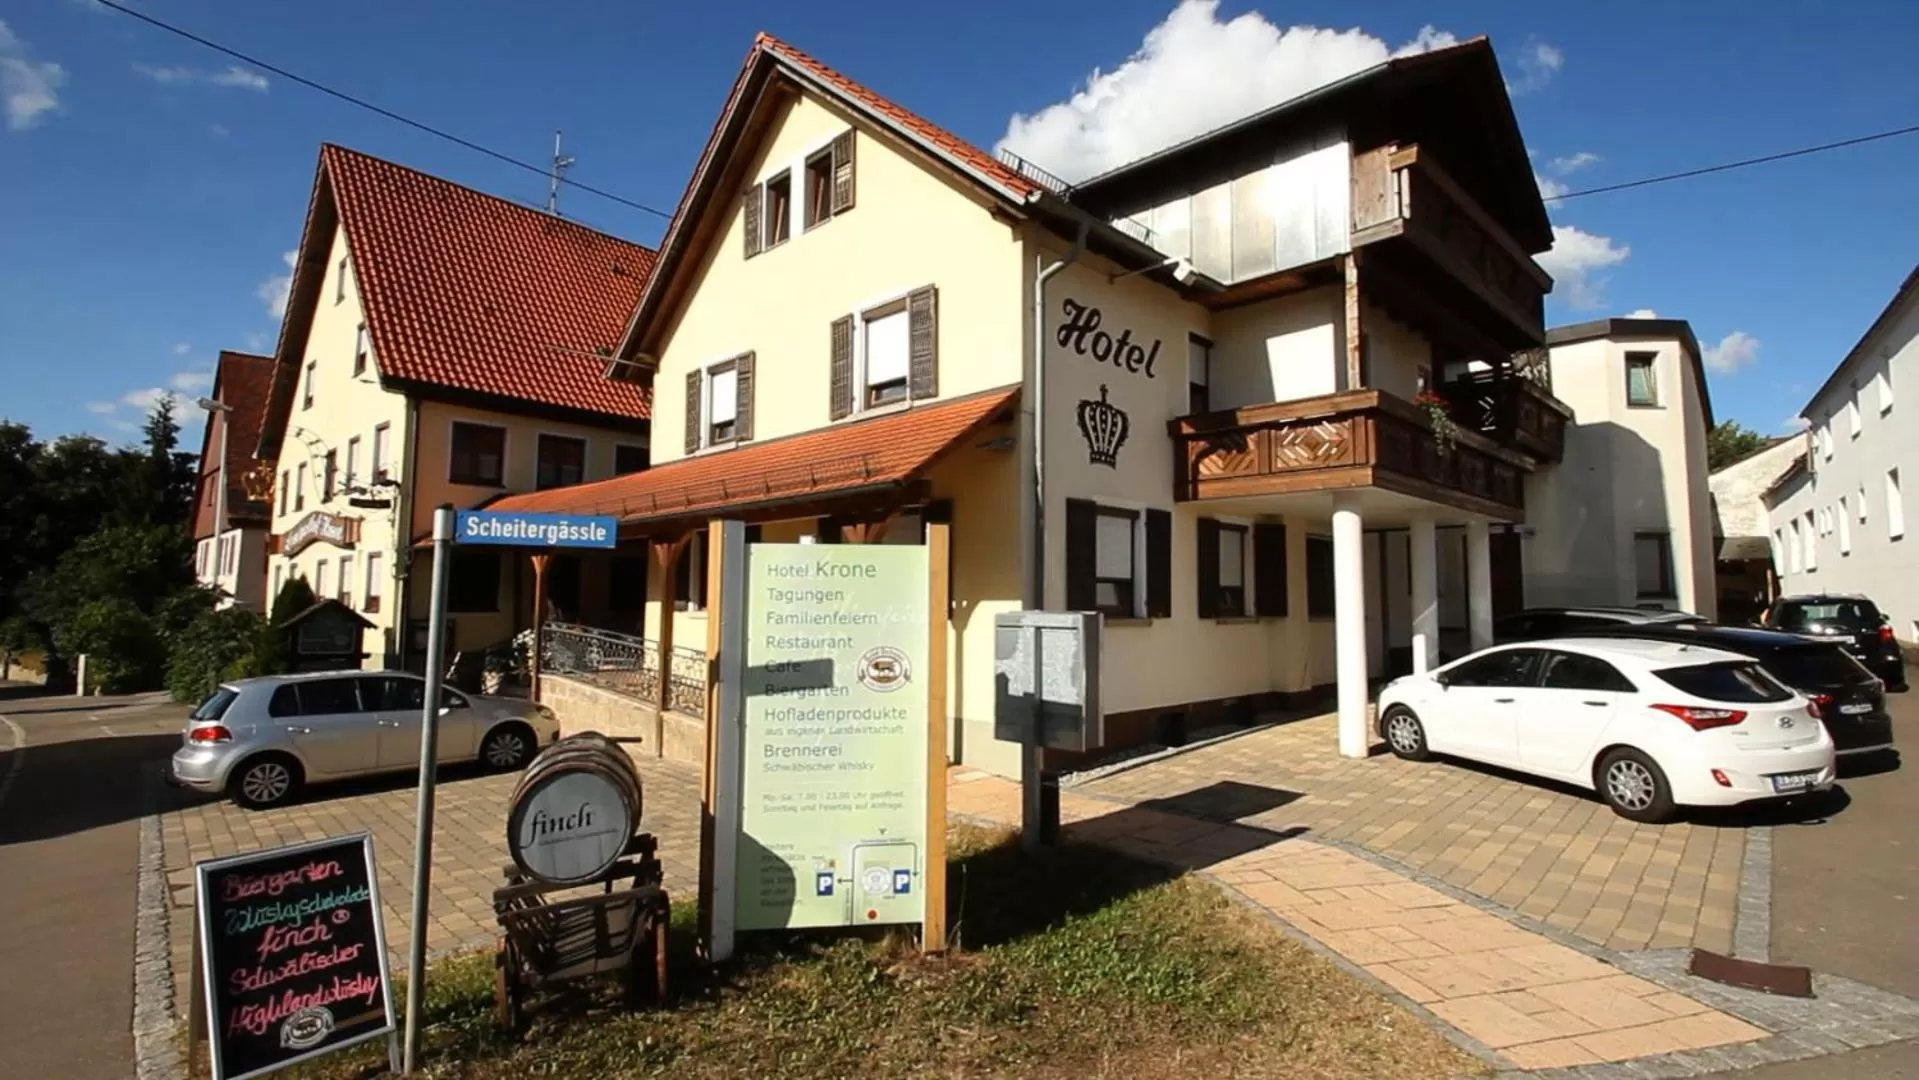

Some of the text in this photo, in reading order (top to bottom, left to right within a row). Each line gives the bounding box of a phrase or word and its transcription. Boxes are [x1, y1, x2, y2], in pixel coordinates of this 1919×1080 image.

[1057, 298, 1162, 379] Hotel
[466, 516, 607, 544] Scheitergässle
[767, 561, 877, 578] Hotel Krone
[767, 587, 845, 604] Tagungen
[766, 610, 879, 626] Familienfeiern
[765, 635, 854, 650] Restaurant
[764, 683, 849, 700] Biergarten
[764, 706, 909, 723] Hofladenprodukte
[763, 743, 843, 759] Brennerei
[520, 802, 594, 850] finch
[221, 860, 344, 899] Biergarten
[257, 916, 333, 962] finch
[229, 942, 365, 994] Schwäbischer
